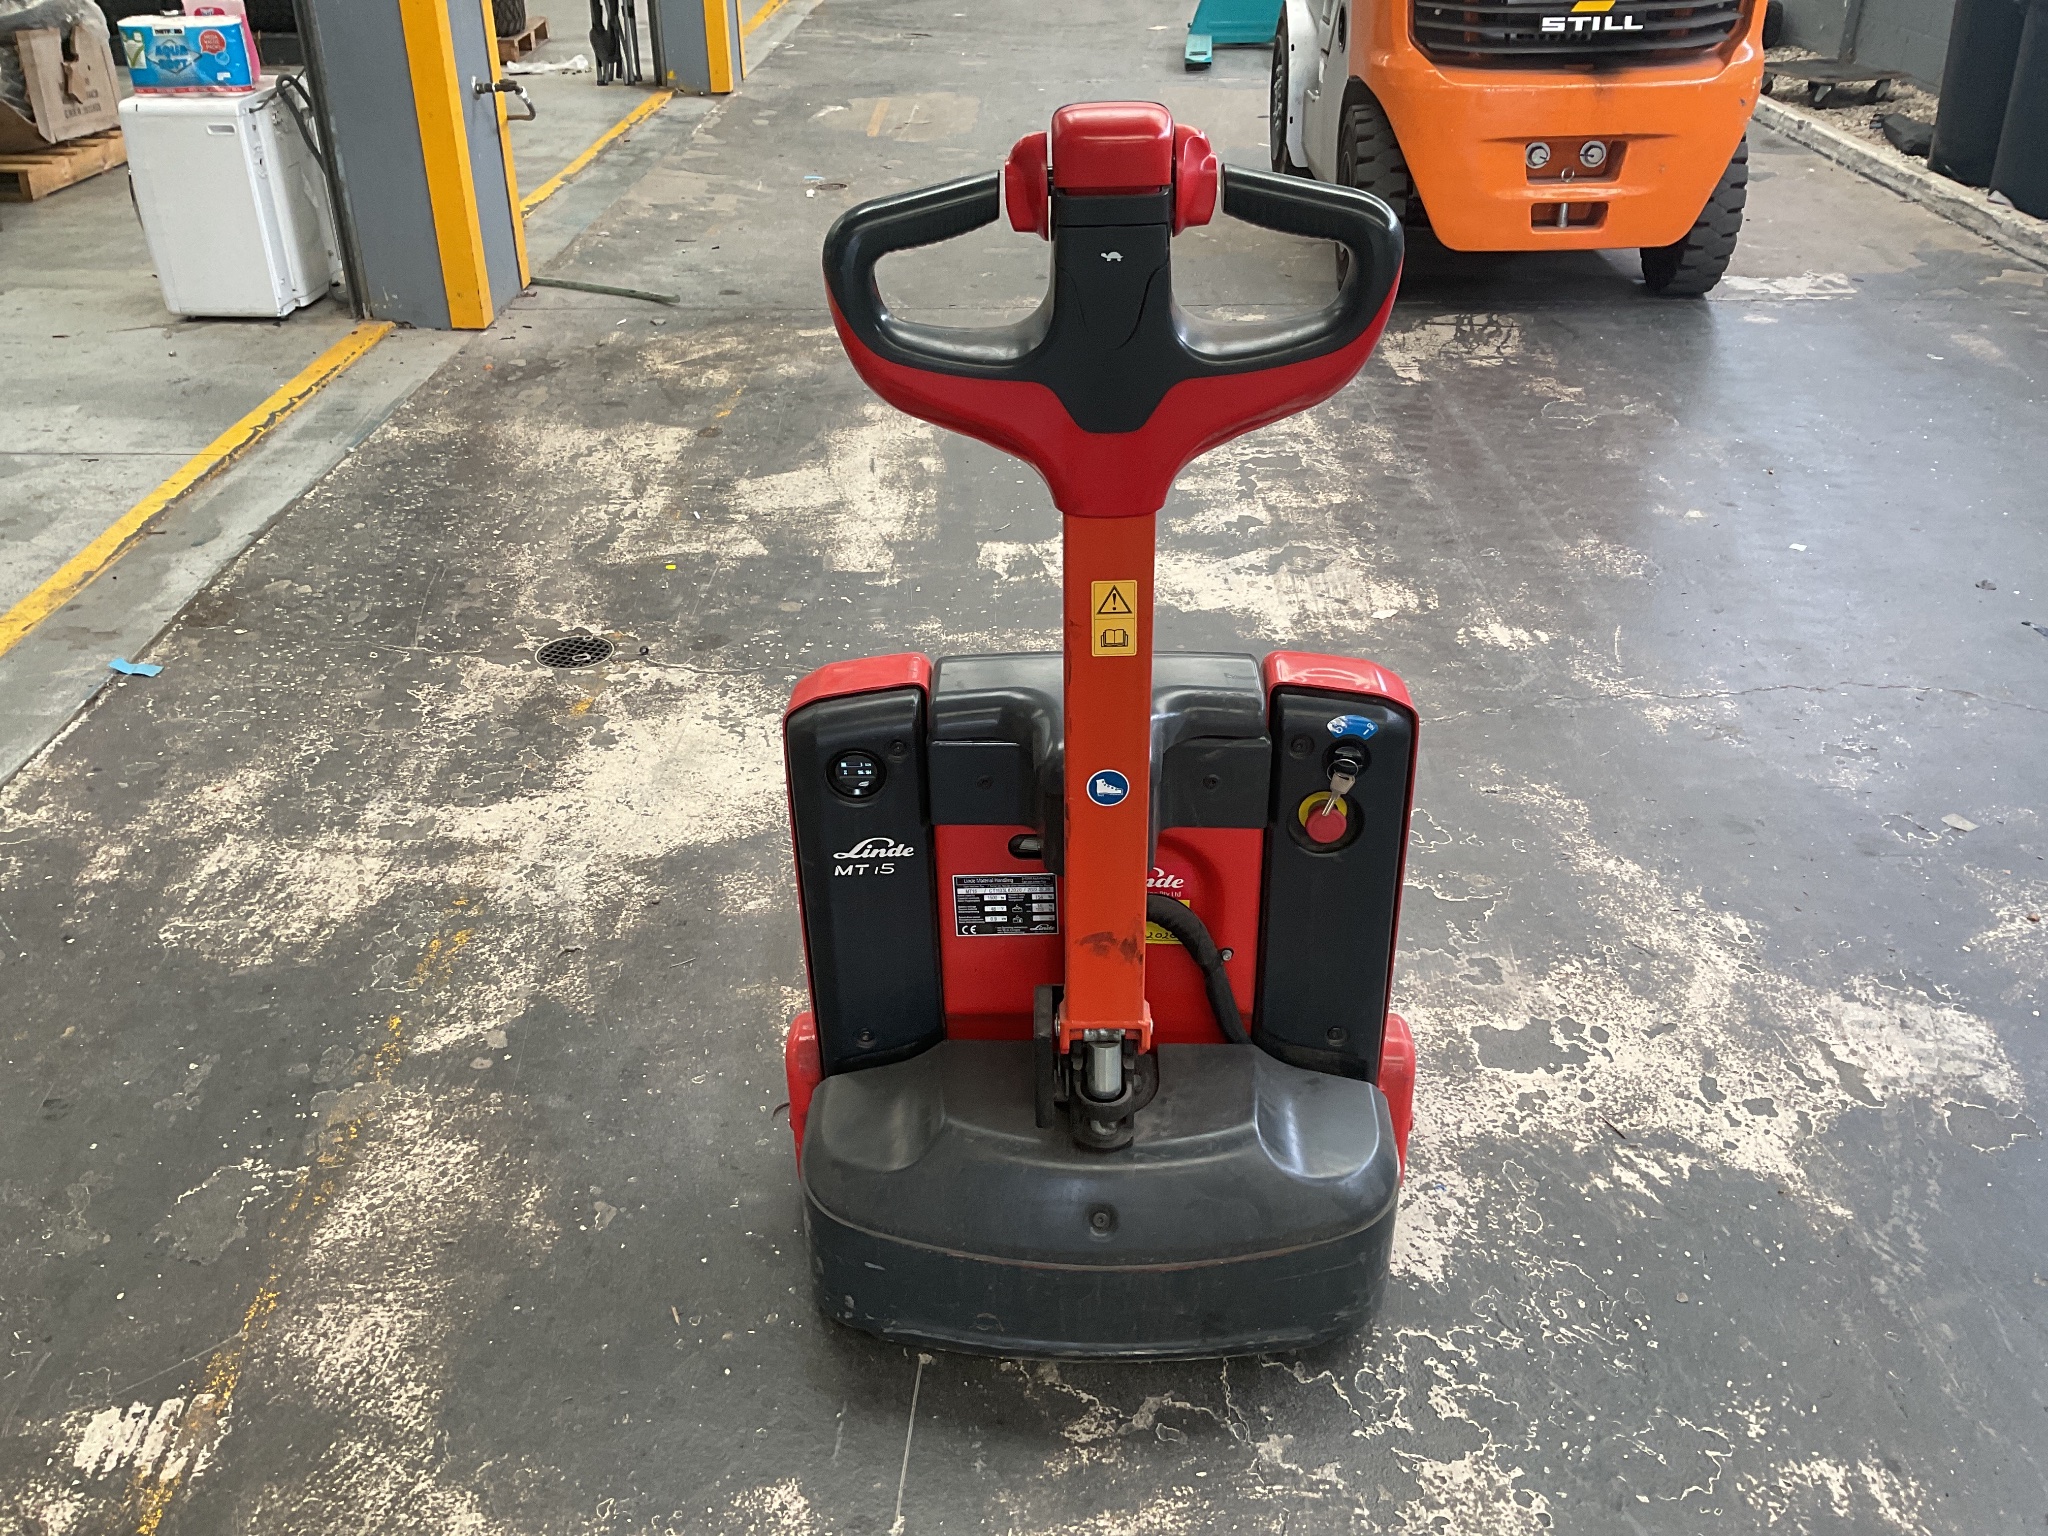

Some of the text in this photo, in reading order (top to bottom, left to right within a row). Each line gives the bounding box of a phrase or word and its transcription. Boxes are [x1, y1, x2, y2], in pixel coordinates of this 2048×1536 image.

[1541, 15, 1644, 32] STILL
[833, 837, 914, 859] Linde
[1147, 867, 1184, 889] nde
